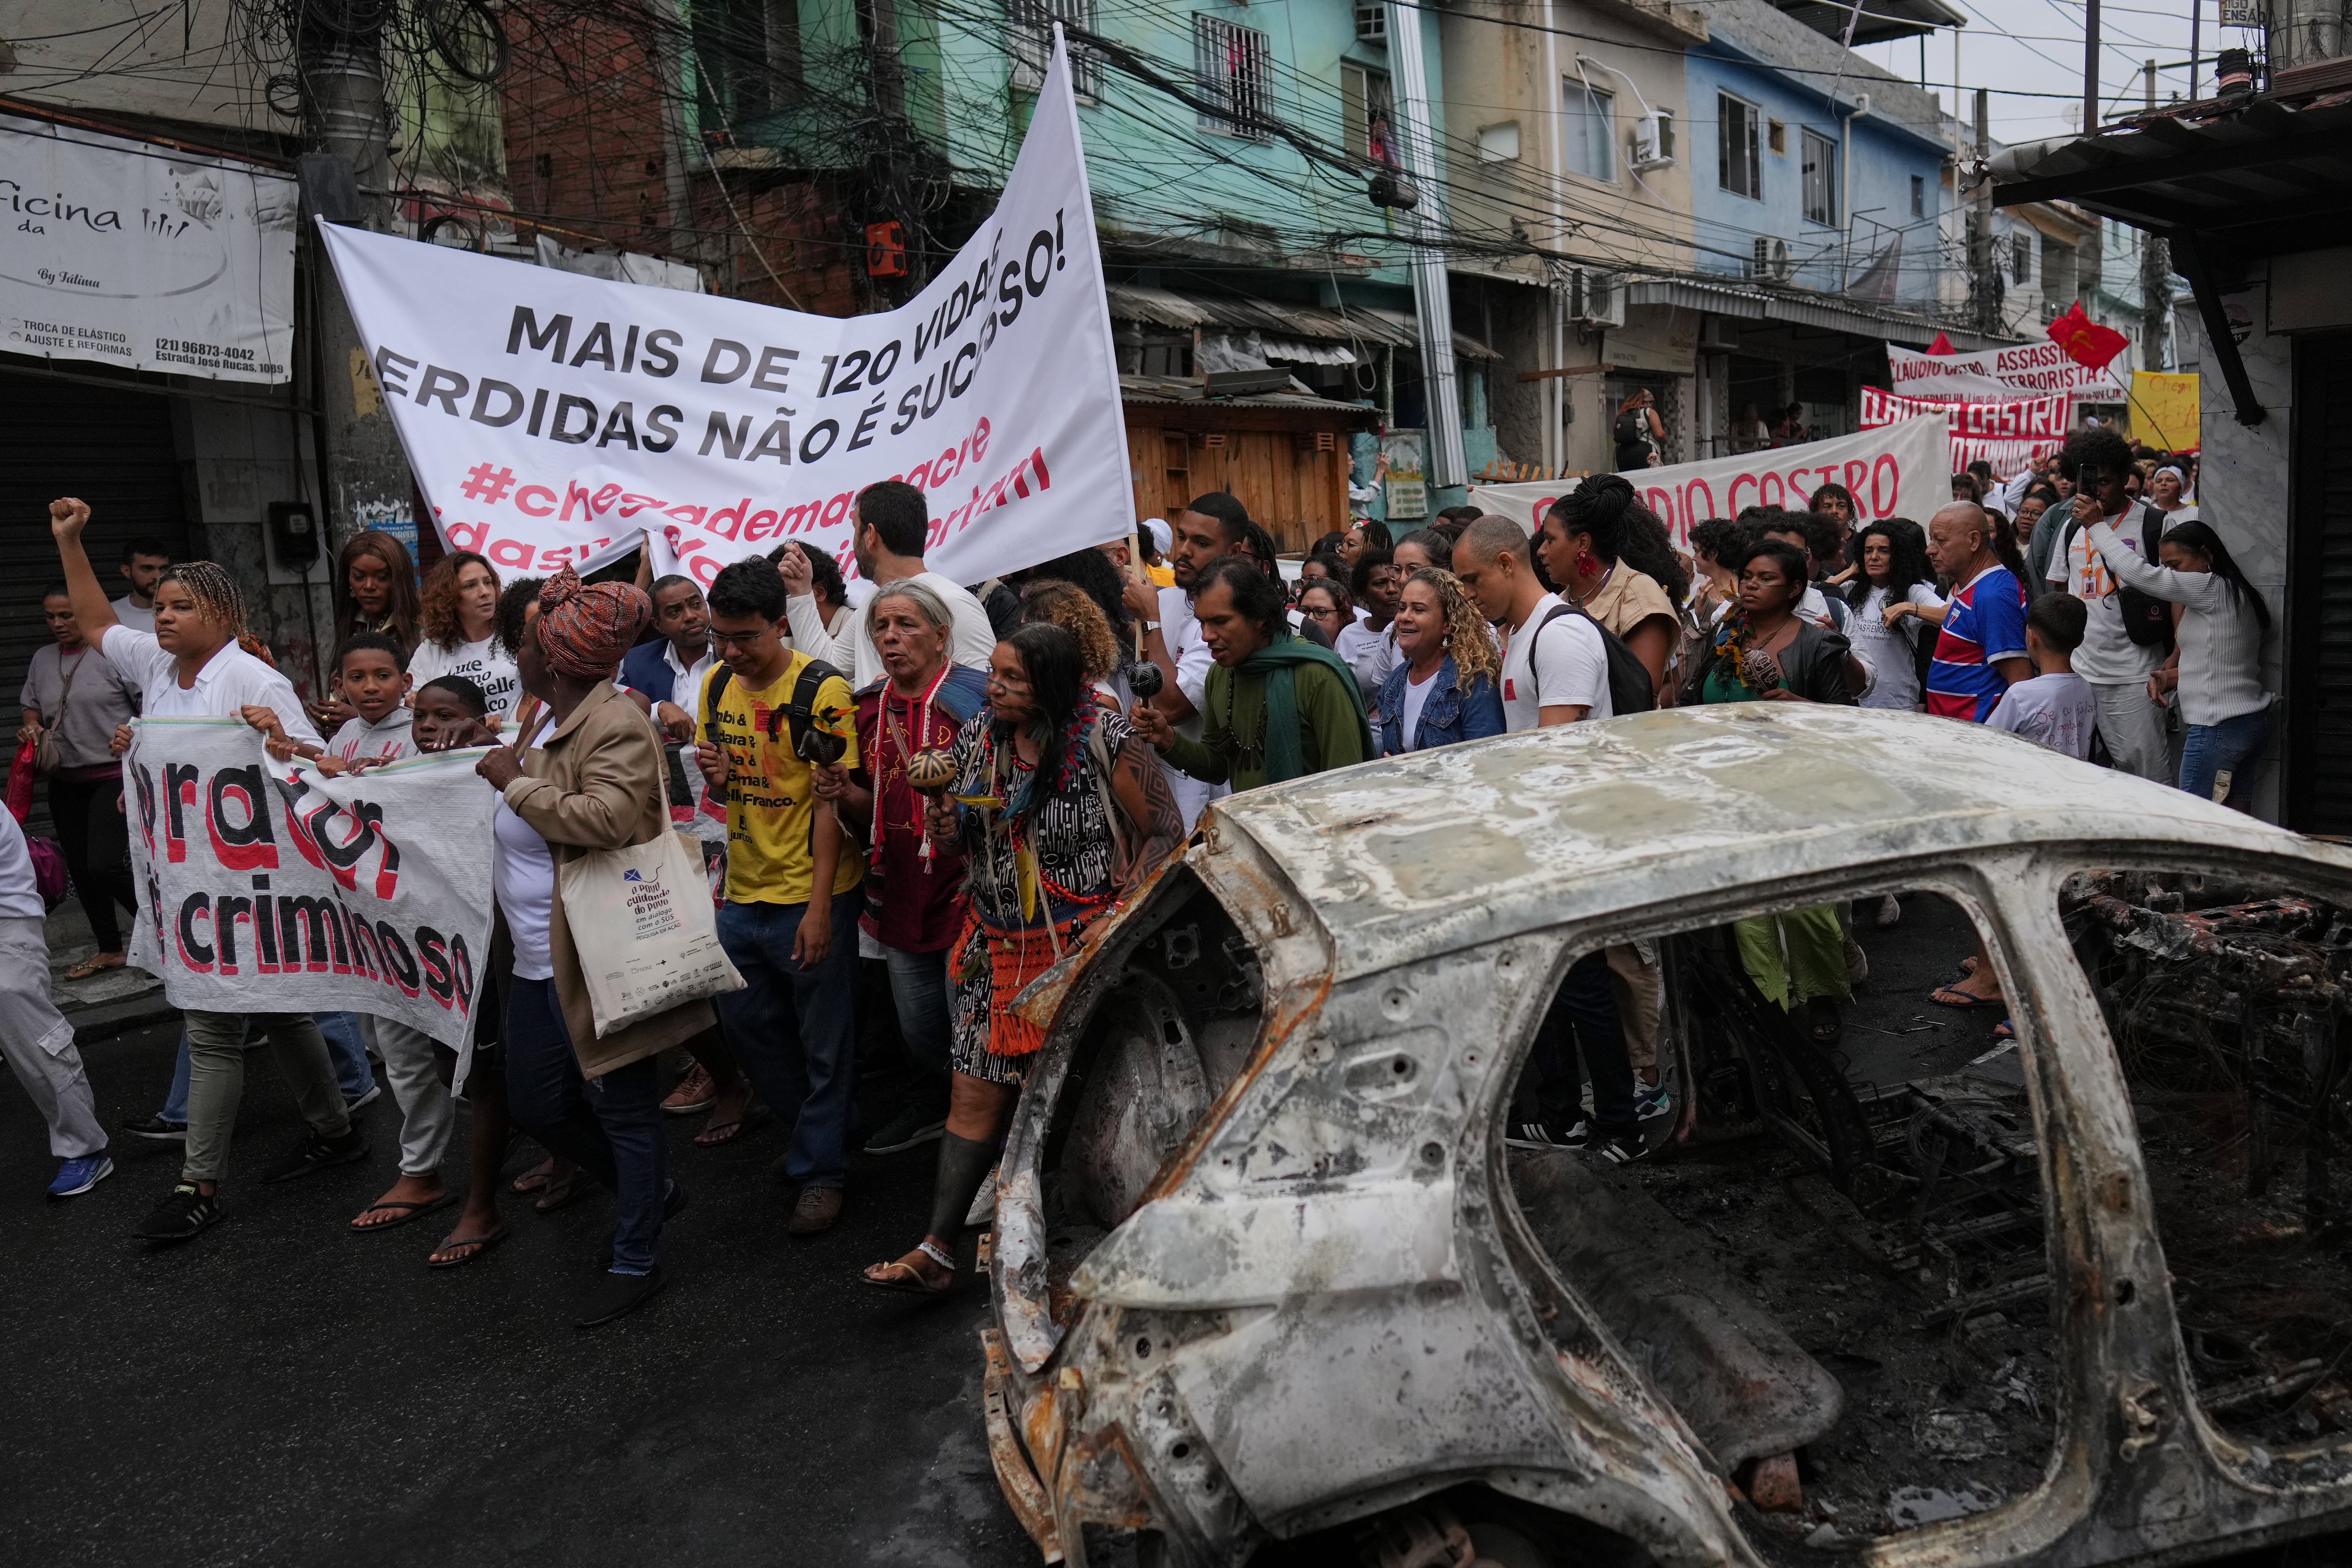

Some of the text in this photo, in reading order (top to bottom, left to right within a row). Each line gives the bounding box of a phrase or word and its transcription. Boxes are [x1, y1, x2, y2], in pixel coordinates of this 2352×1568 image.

[2221, 0, 2248, 9] IGO
[2223, 9, 2266, 23] ENSÃO
[18, 219, 45, 235] da
[38, 268, 55, 285] By
[506, 227, 1004, 398] MAIS DE 120 VIDAS
[24, 320, 126, 343] TROCA DE ELÁSTICO
[375, 345, 684, 454] ERDIDAS
[698, 407, 839, 466] NÃO
[846, 389, 887, 452] É
[890, 206, 1066, 436] SUCESSO!
[25, 334, 132, 356] AJUSTE E REFORMAS
[156, 338, 254, 360] (21) 96873-4042
[156, 351, 195, 365] Estrada
[197, 356, 220, 368] José
[259, 363, 284, 373] 1089
[1967, 392, 2068, 436] CASTRO
[1727, 453, 1900, 523] CASTRO
[2079, 565, 2120, 599] 10
[737, 714, 747, 727] &
[2036, 705, 2056, 725] Se
[2063, 707, 2072, 716] eu
[748, 735, 756, 748] &
[748, 754, 757, 767] &
[761, 776, 770, 789] &
[743, 793, 797, 808] Franco.
[729, 830, 753, 844] juntos
[627, 889, 670, 907] cuidando
[634, 904, 646, 915] do
[648, 908, 672, 920] diálogo
[638, 922, 653, 931] com
[661, 913, 674, 923] SUS
[636, 931, 660, 941] PESQUISA
[668, 922, 681, 931] AÇÃO
[174, 873, 474, 1020] criminoso
